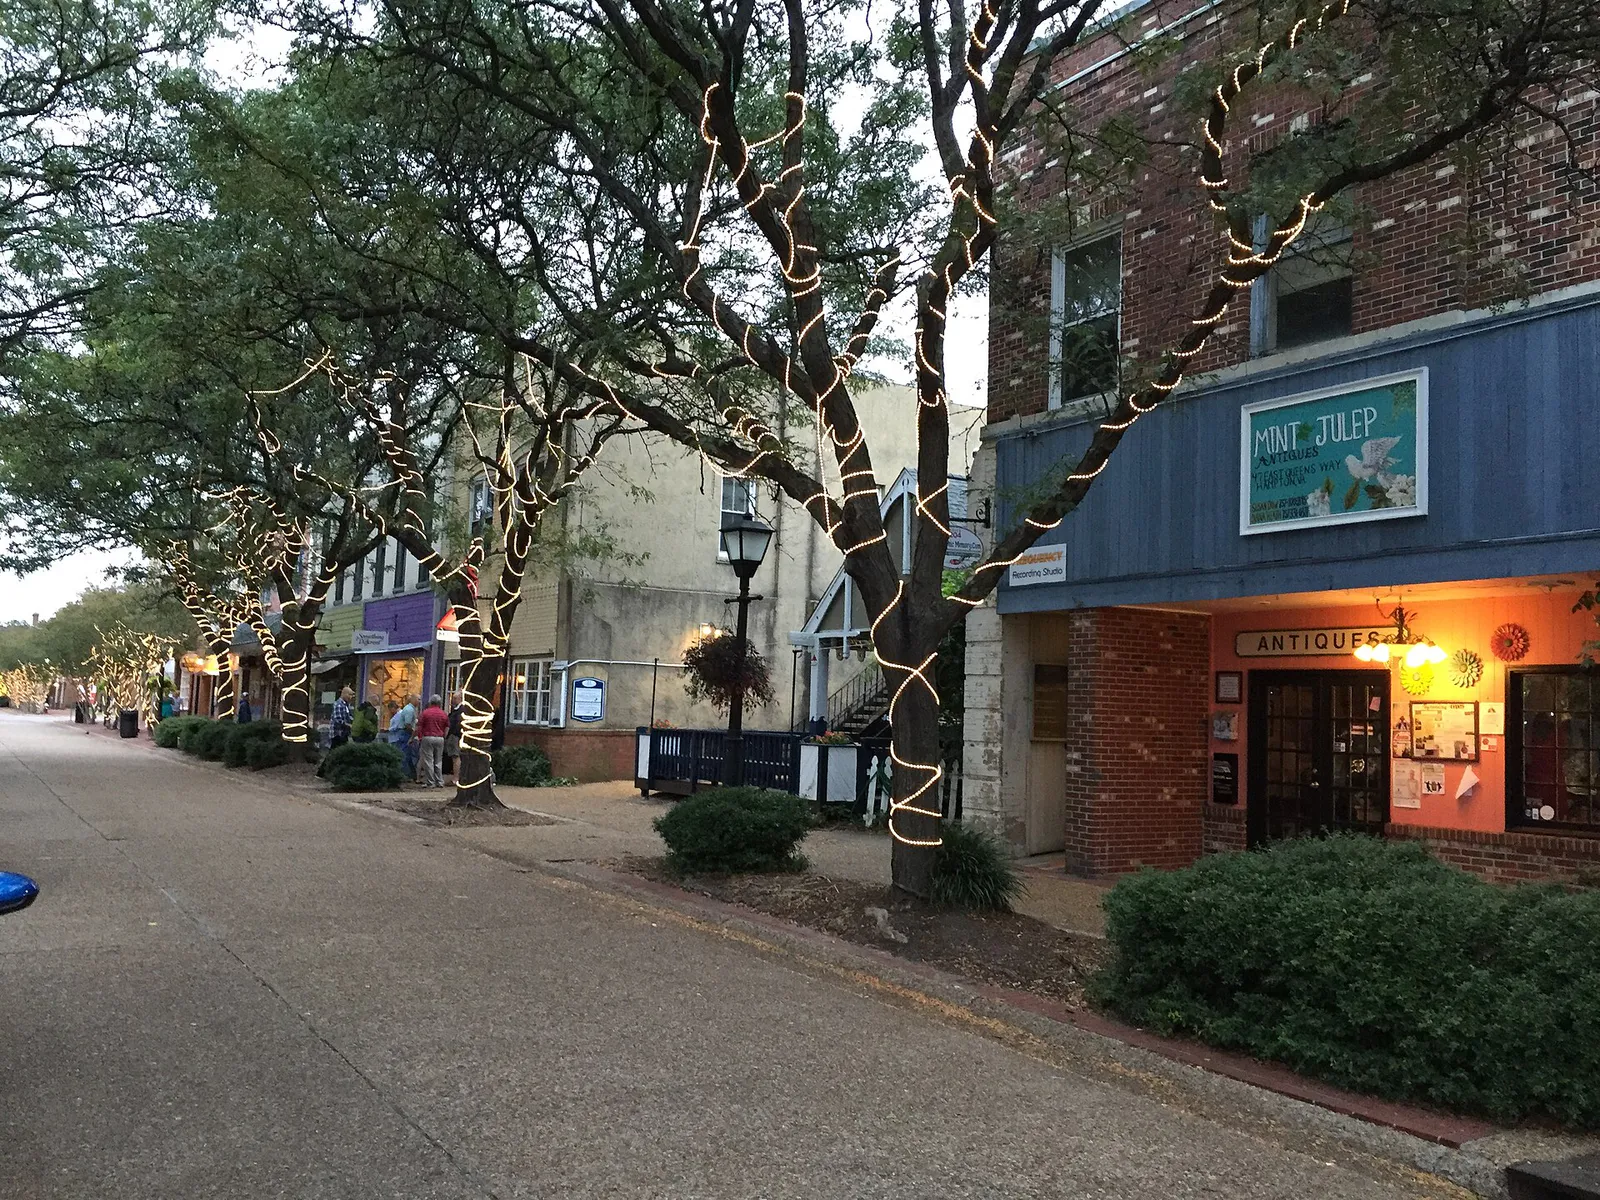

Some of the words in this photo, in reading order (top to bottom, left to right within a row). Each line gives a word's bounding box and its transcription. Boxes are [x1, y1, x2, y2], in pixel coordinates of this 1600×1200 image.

[1254, 421, 1301, 457] MINT
[1315, 407, 1377, 446] JULEP
[1256, 446, 1319, 469] ANTIQUES
[1284, 463, 1316, 477] QUEENS
[1320, 460, 1341, 472] WAY
[1012, 569, 1042, 579] Recording
[1043, 567, 1063, 577] Studio
[1257, 631, 1380, 652] ANTIQUES
